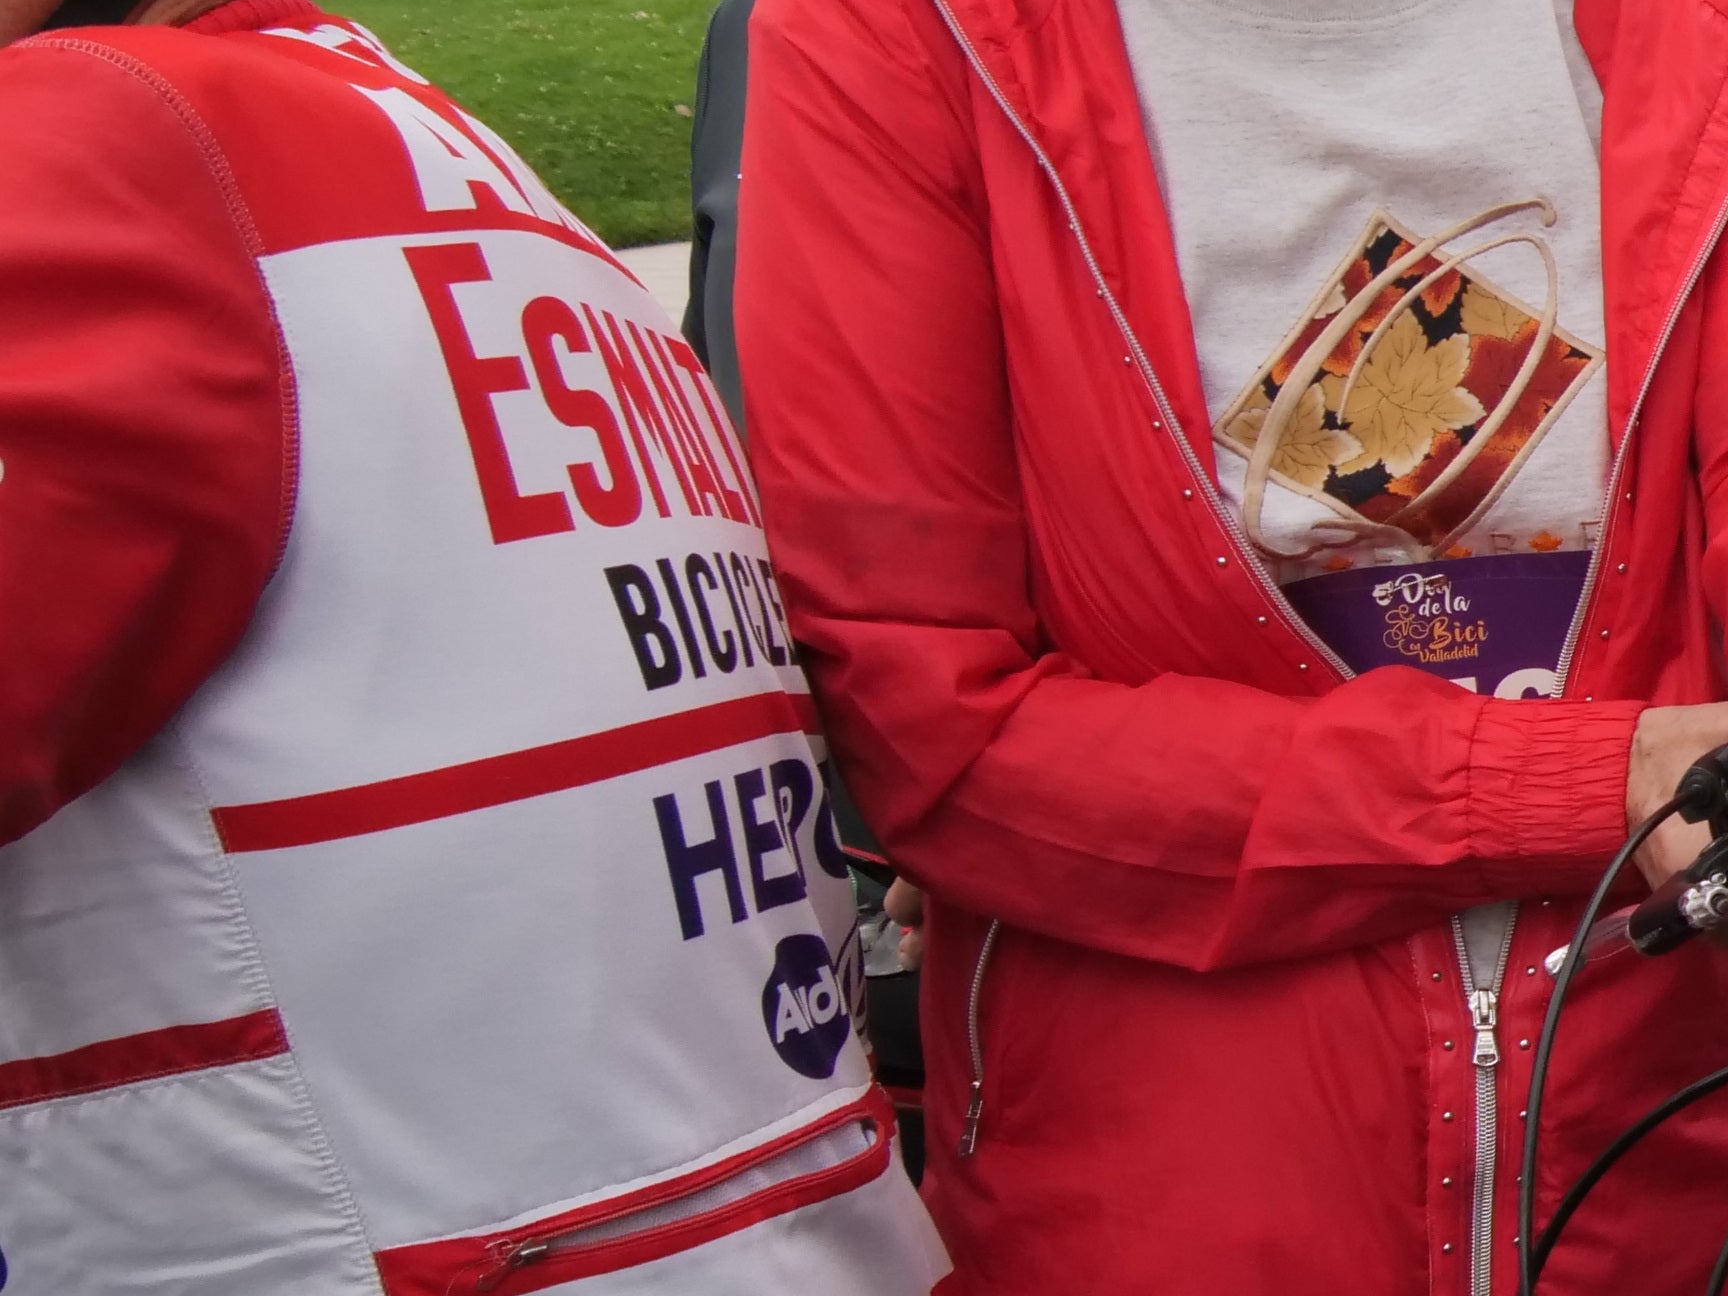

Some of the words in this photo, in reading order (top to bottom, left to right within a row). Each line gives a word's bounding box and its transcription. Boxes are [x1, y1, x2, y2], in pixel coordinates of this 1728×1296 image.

[1418, 597, 1443, 618] de
[1428, 615, 1489, 650] Bici
[1418, 642, 1480, 664] Valladolid
